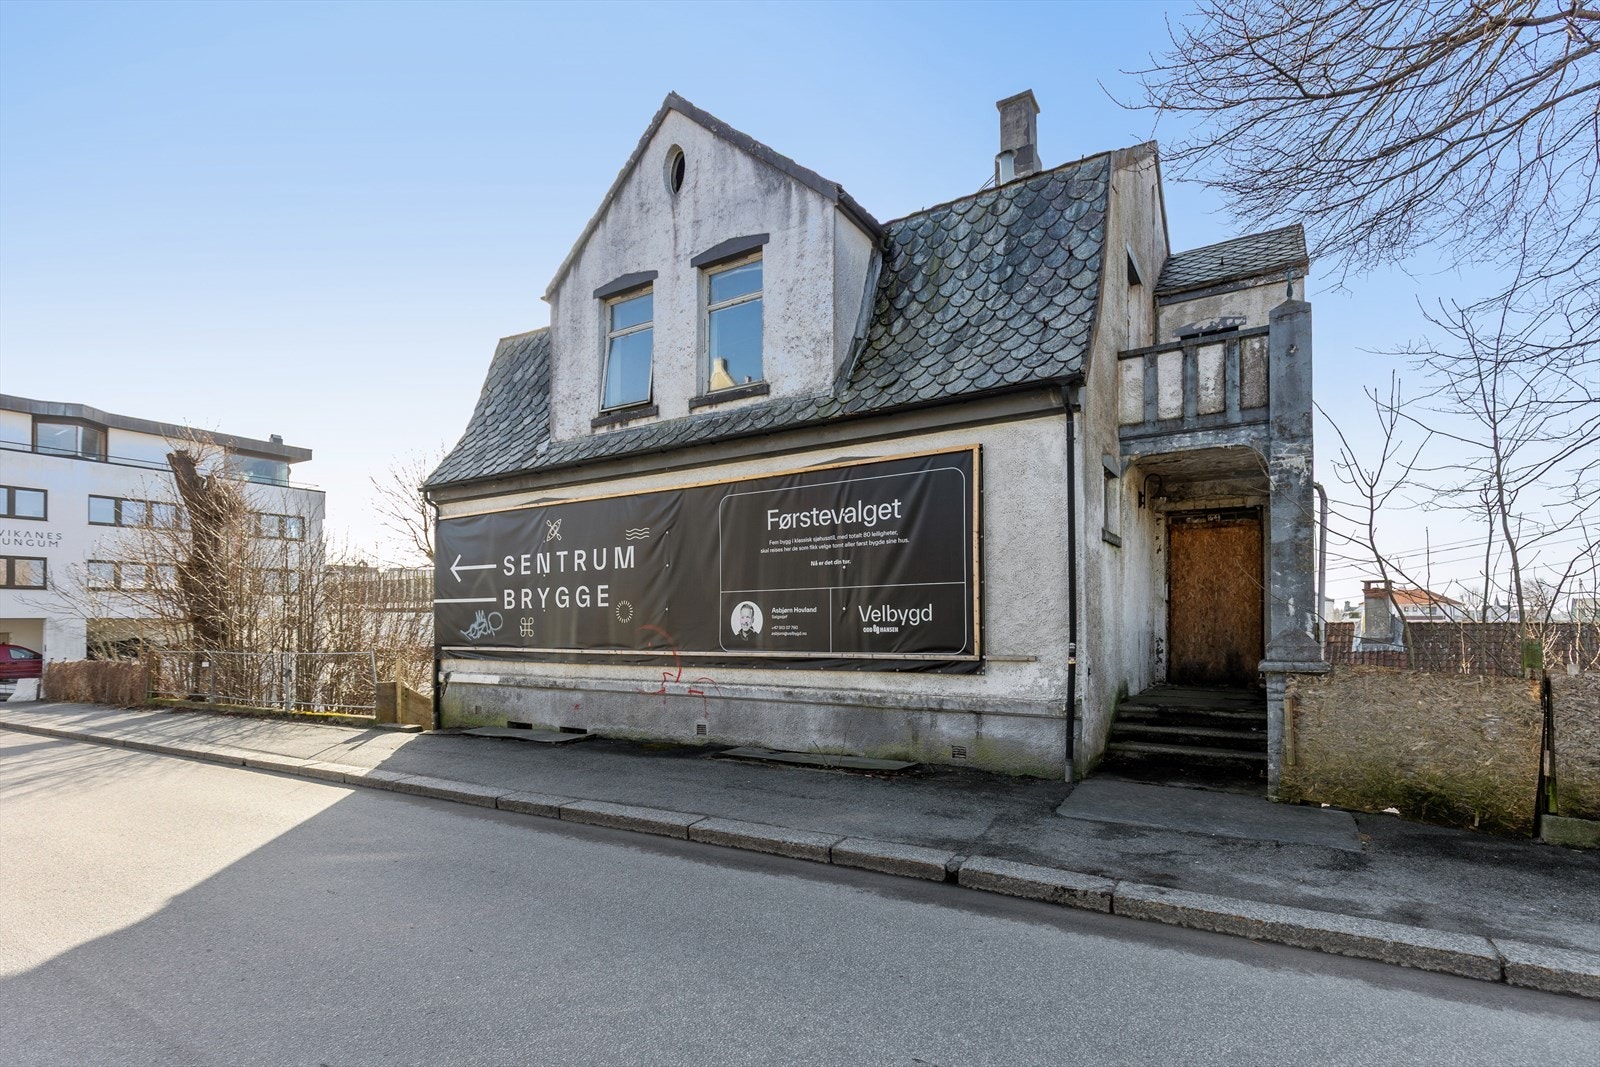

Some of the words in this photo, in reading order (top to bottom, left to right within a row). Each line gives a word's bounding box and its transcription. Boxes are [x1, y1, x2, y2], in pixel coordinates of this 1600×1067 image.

[767, 499, 902, 531] Førstevalget
[503, 545, 635, 576] SENTRUM
[503, 584, 609, 610] BRYGGE
[858, 603, 932, 626] Velbygd
